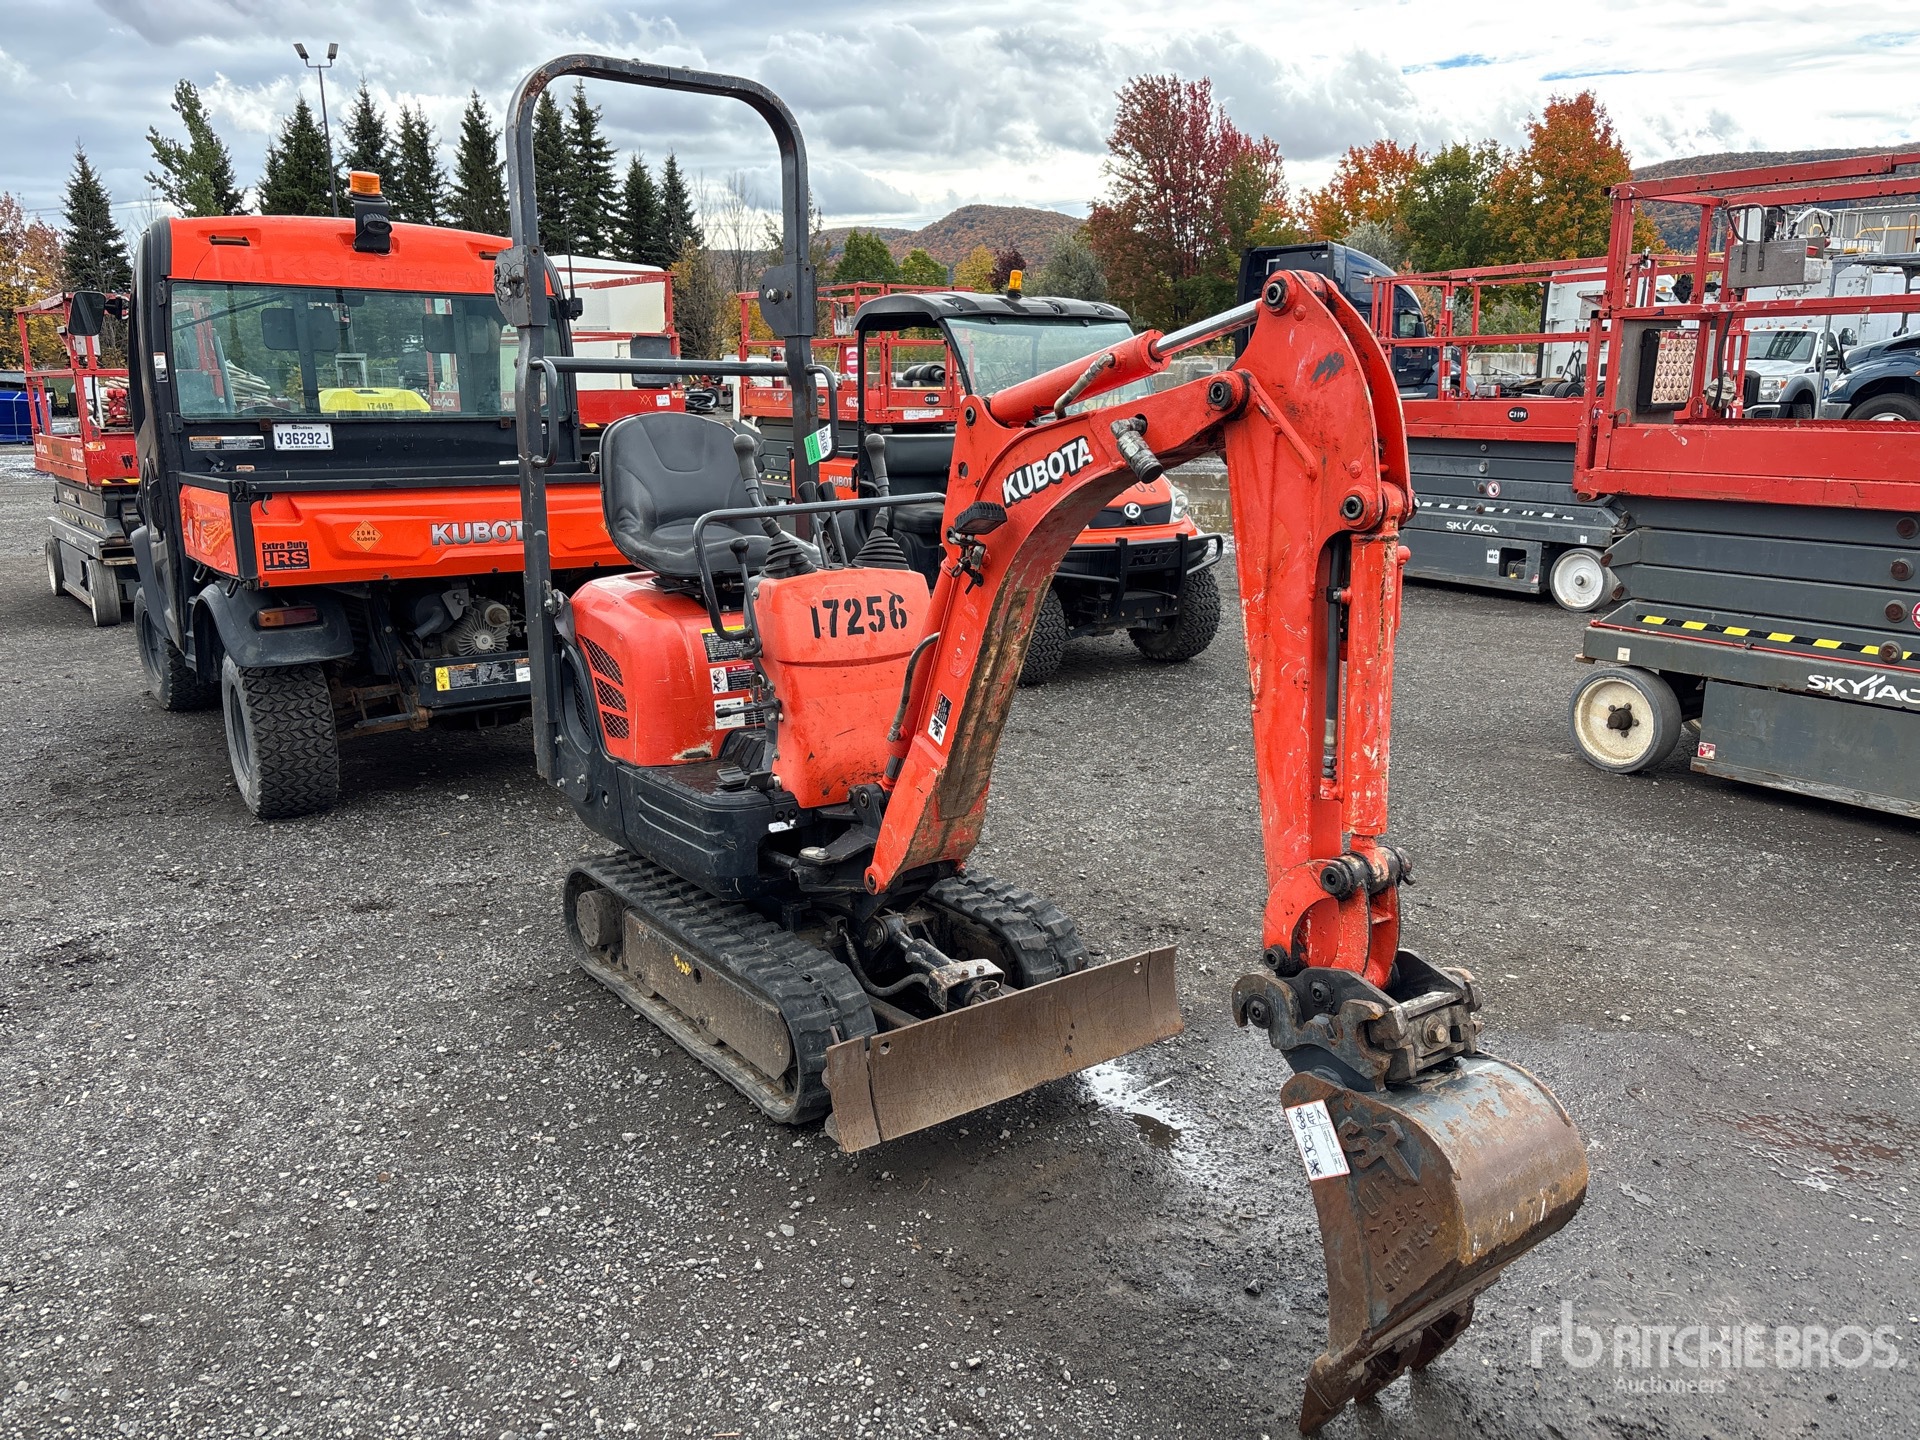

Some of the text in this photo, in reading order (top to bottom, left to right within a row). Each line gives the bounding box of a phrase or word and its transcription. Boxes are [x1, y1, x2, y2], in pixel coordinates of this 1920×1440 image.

[277, 432, 329, 445] V36292J
[1002, 437, 1094, 504] KUBOTA
[828, 475, 852, 487] KUBOT
[431, 520, 523, 546] KUBOT
[1446, 519, 1499, 534] SKYAC
[262, 541, 308, 550] Extra Duty
[810, 593, 908, 639] 17256
